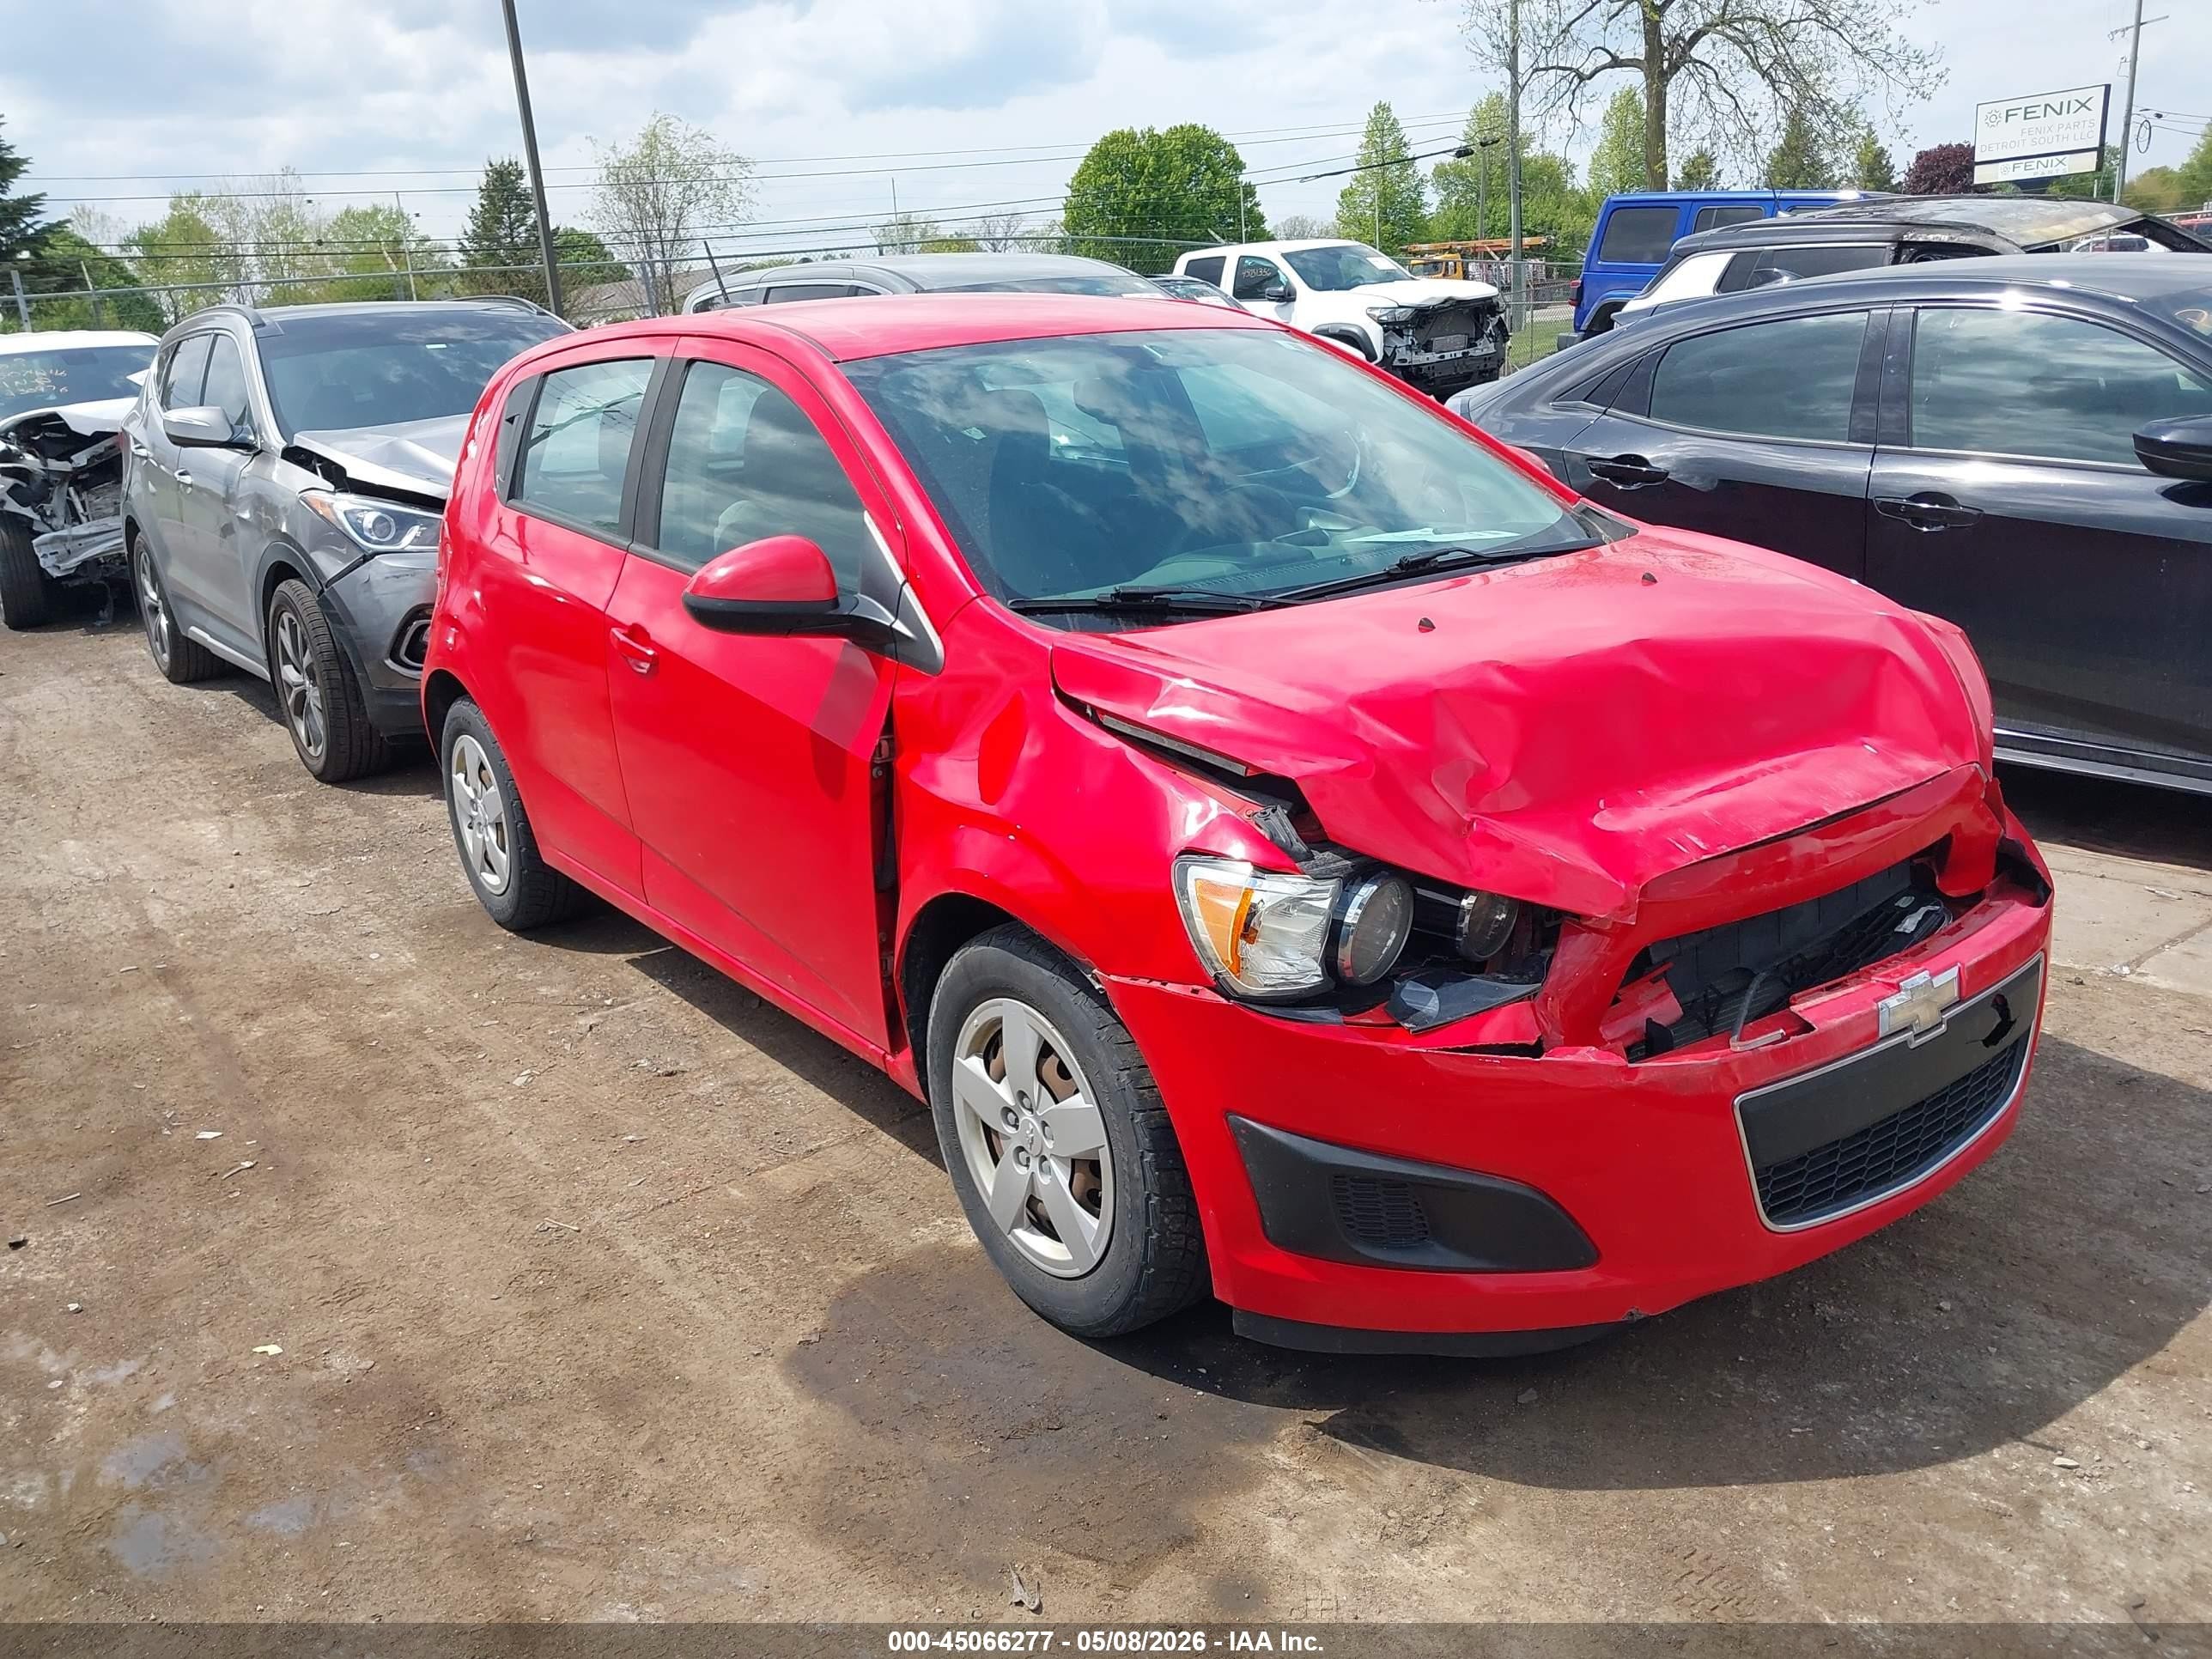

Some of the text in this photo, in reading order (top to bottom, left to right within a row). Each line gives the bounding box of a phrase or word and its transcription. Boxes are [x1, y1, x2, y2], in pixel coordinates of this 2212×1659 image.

[2005, 96, 2094, 123] FENIX
[2021, 118, 2096, 137] FENIX PARTS
[1980, 130, 2095, 153] DETROIT SOUTH LLC
[2012, 157, 2068, 172] FENIX
